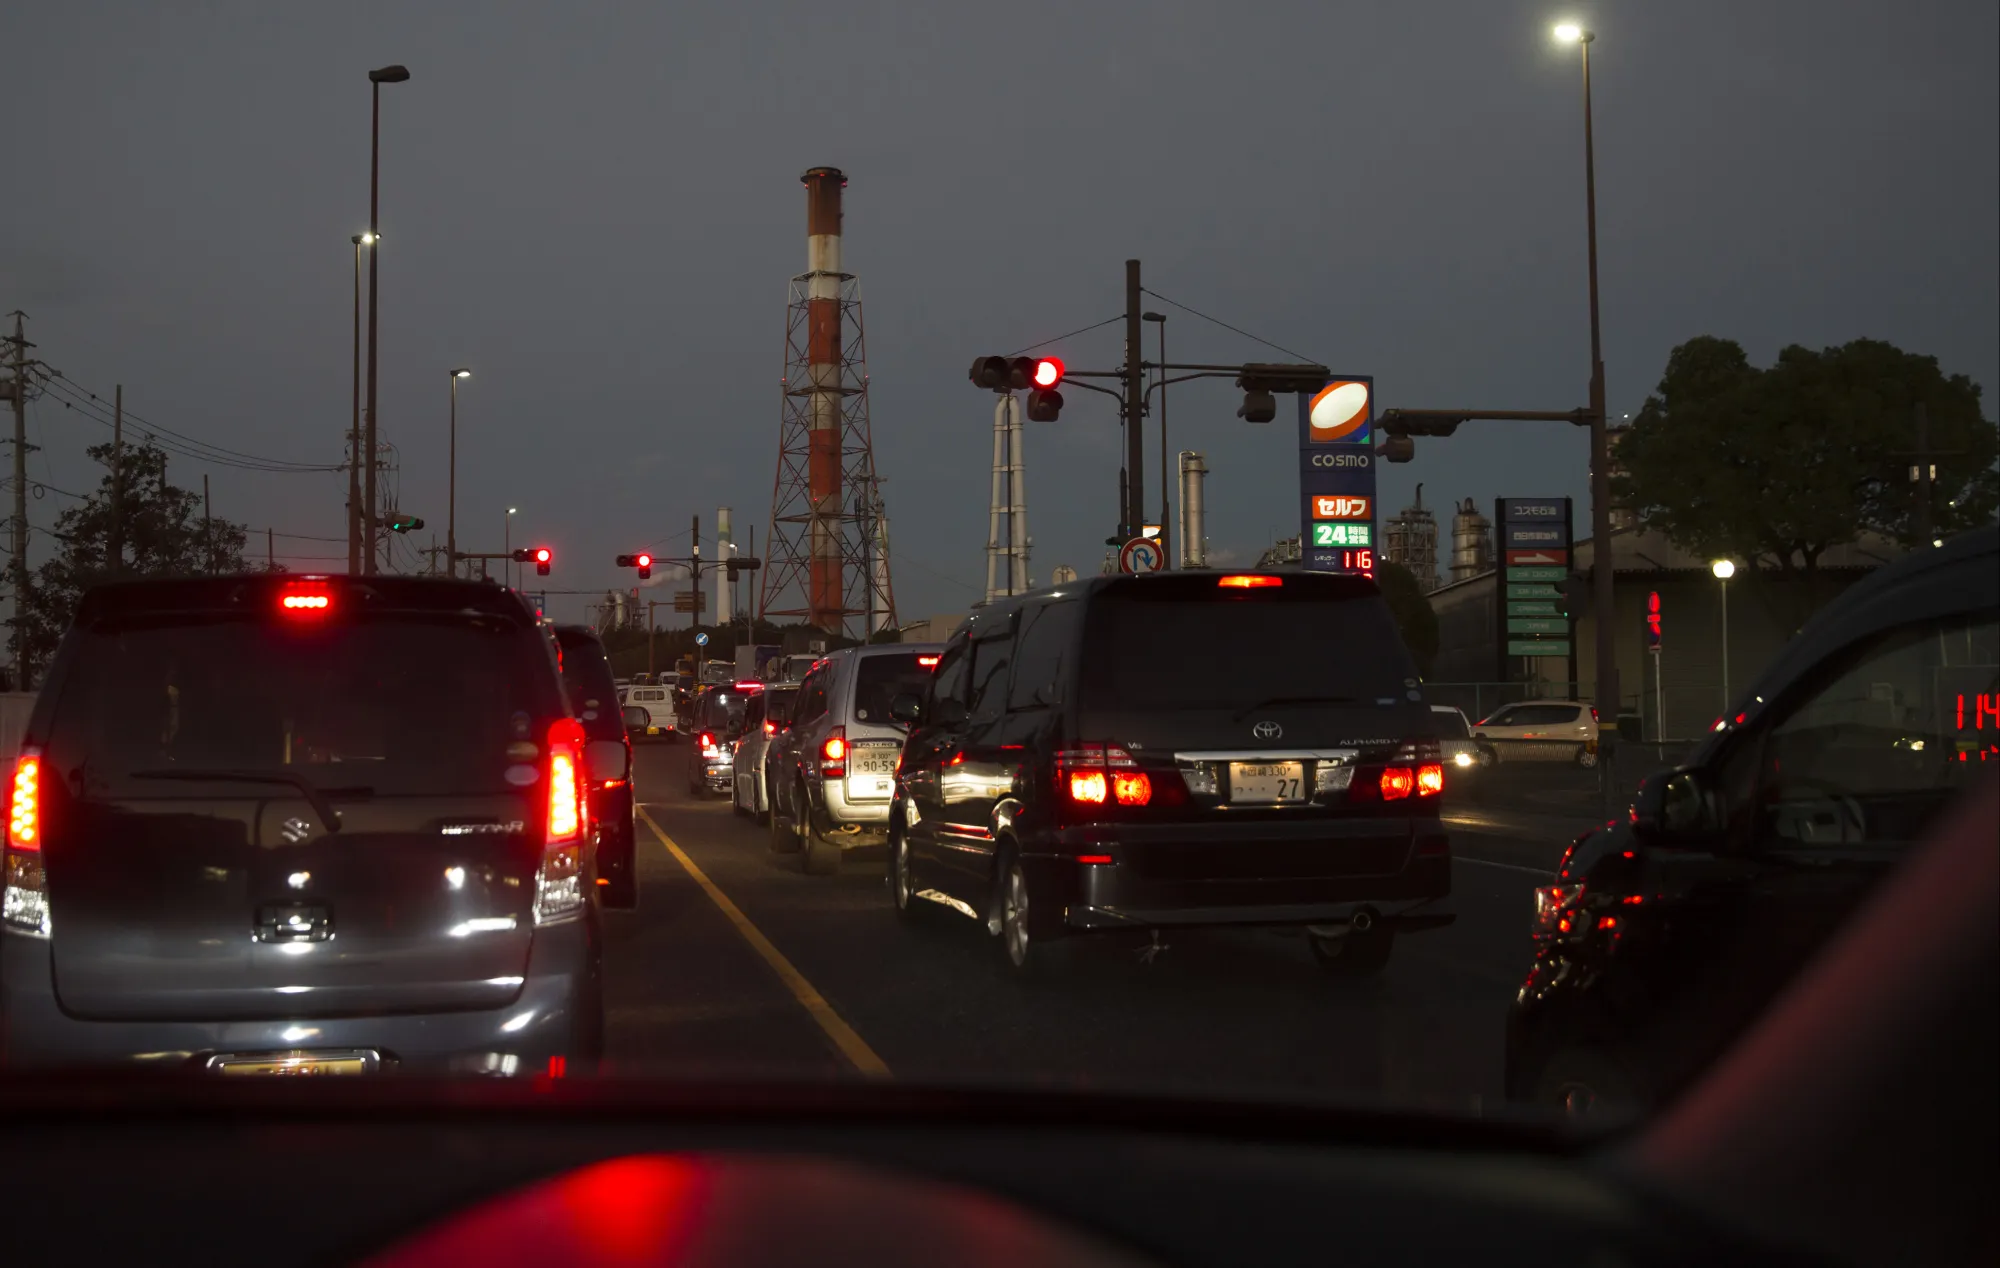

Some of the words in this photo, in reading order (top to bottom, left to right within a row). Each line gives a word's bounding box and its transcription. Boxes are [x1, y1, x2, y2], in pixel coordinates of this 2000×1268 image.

[1312, 454, 1369, 468] COSMO
[1318, 498, 1366, 516] セルフ
[1514, 506, 1557, 515] コスモ石油
[1317, 525, 1347, 544] 24
[1346, 551, 1371, 568] 116
[1957, 693, 2000, 730] 114
[864, 761, 895, 772] 90-59
[1268, 765, 1287, 776] 330
